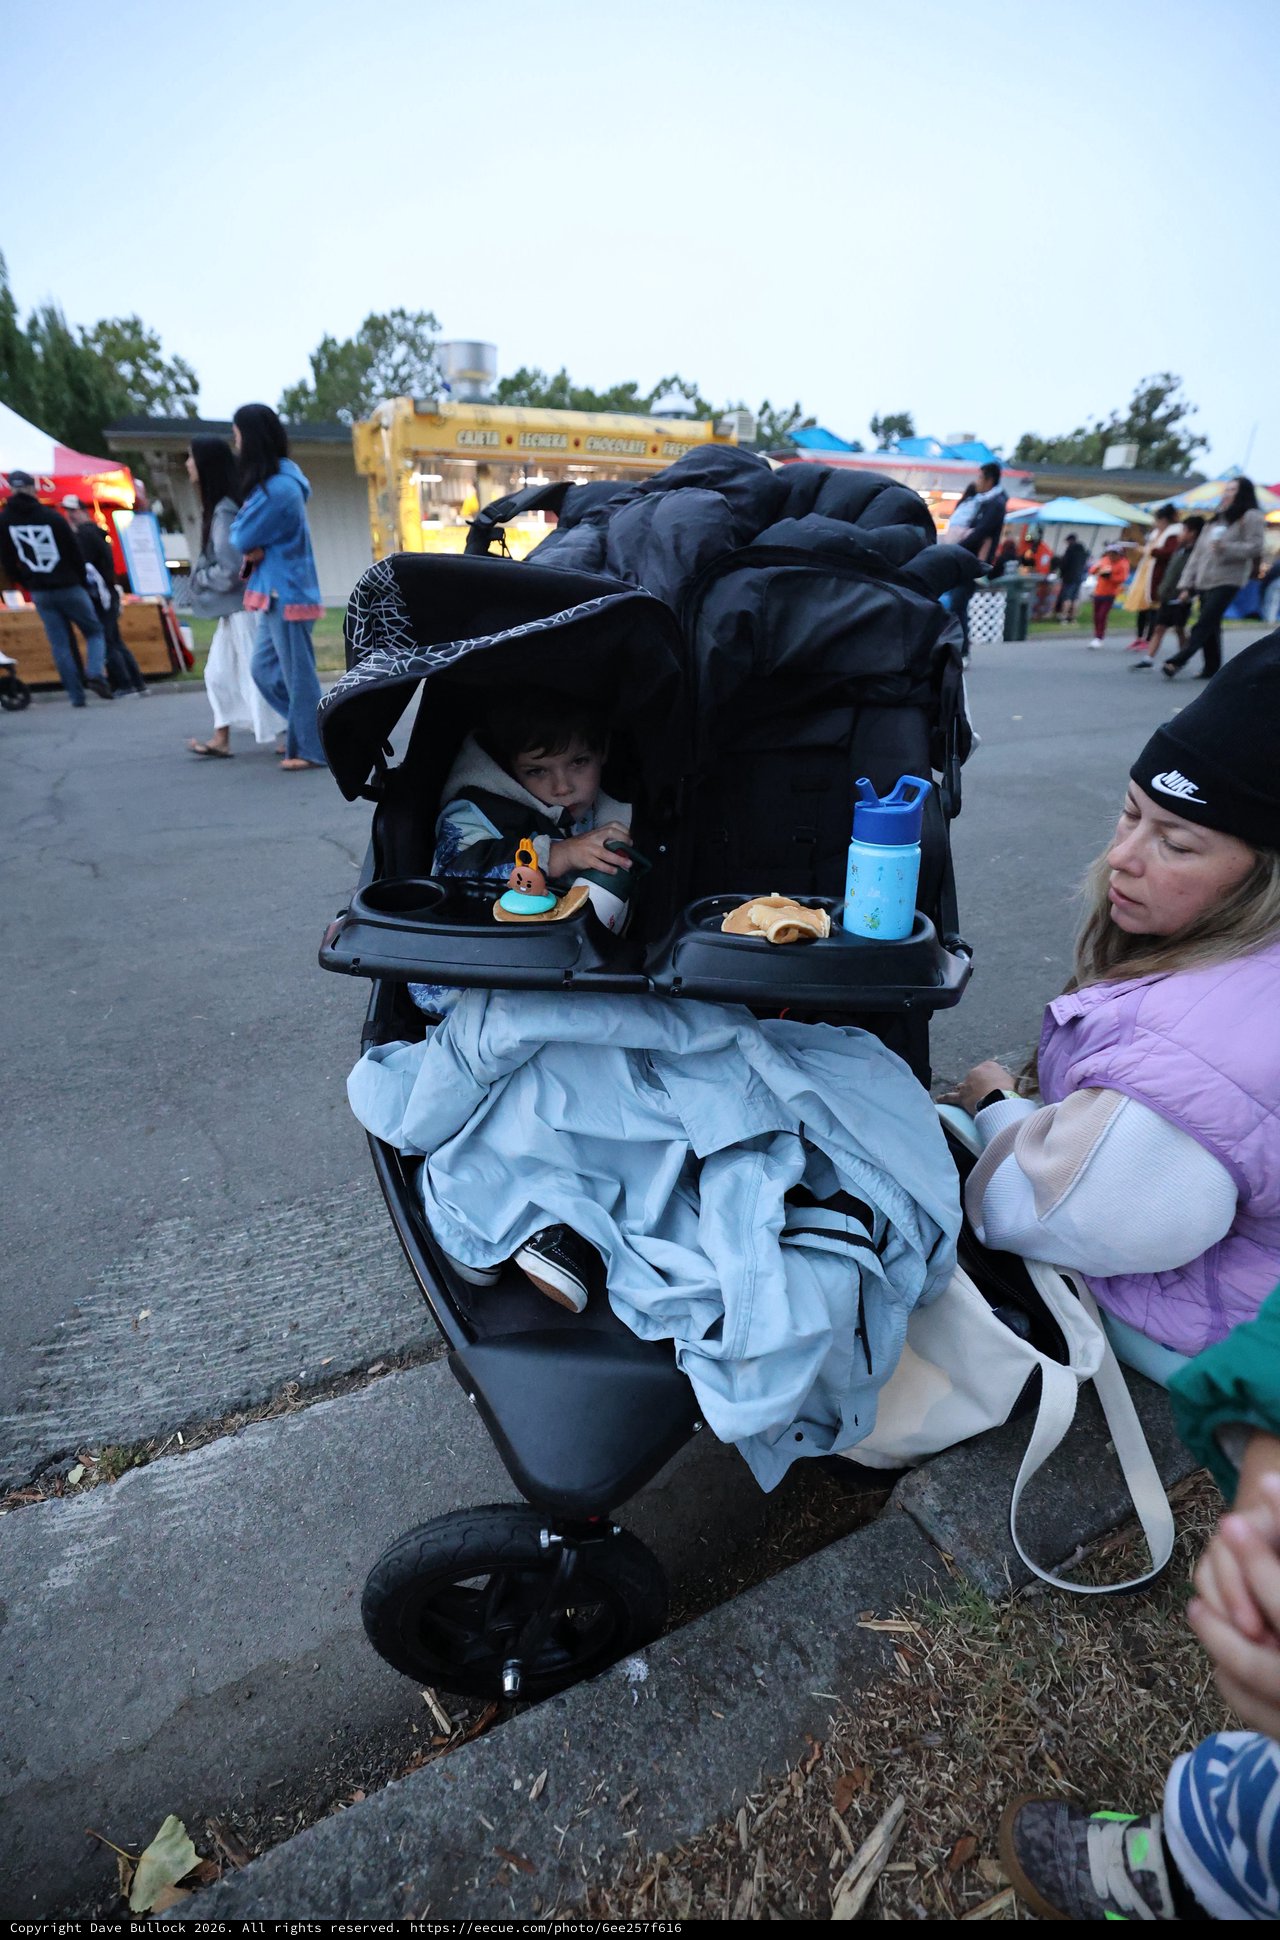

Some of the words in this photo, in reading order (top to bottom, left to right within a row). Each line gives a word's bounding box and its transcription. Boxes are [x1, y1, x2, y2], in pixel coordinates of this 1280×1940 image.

[457, 430, 499, 446] CAJETA
[518, 432, 568, 448] LECHERA
[585, 436, 647, 455] CHOCOLATE
[662, 441, 692, 456] FRES
[1161, 769, 1200, 796] NIKE
